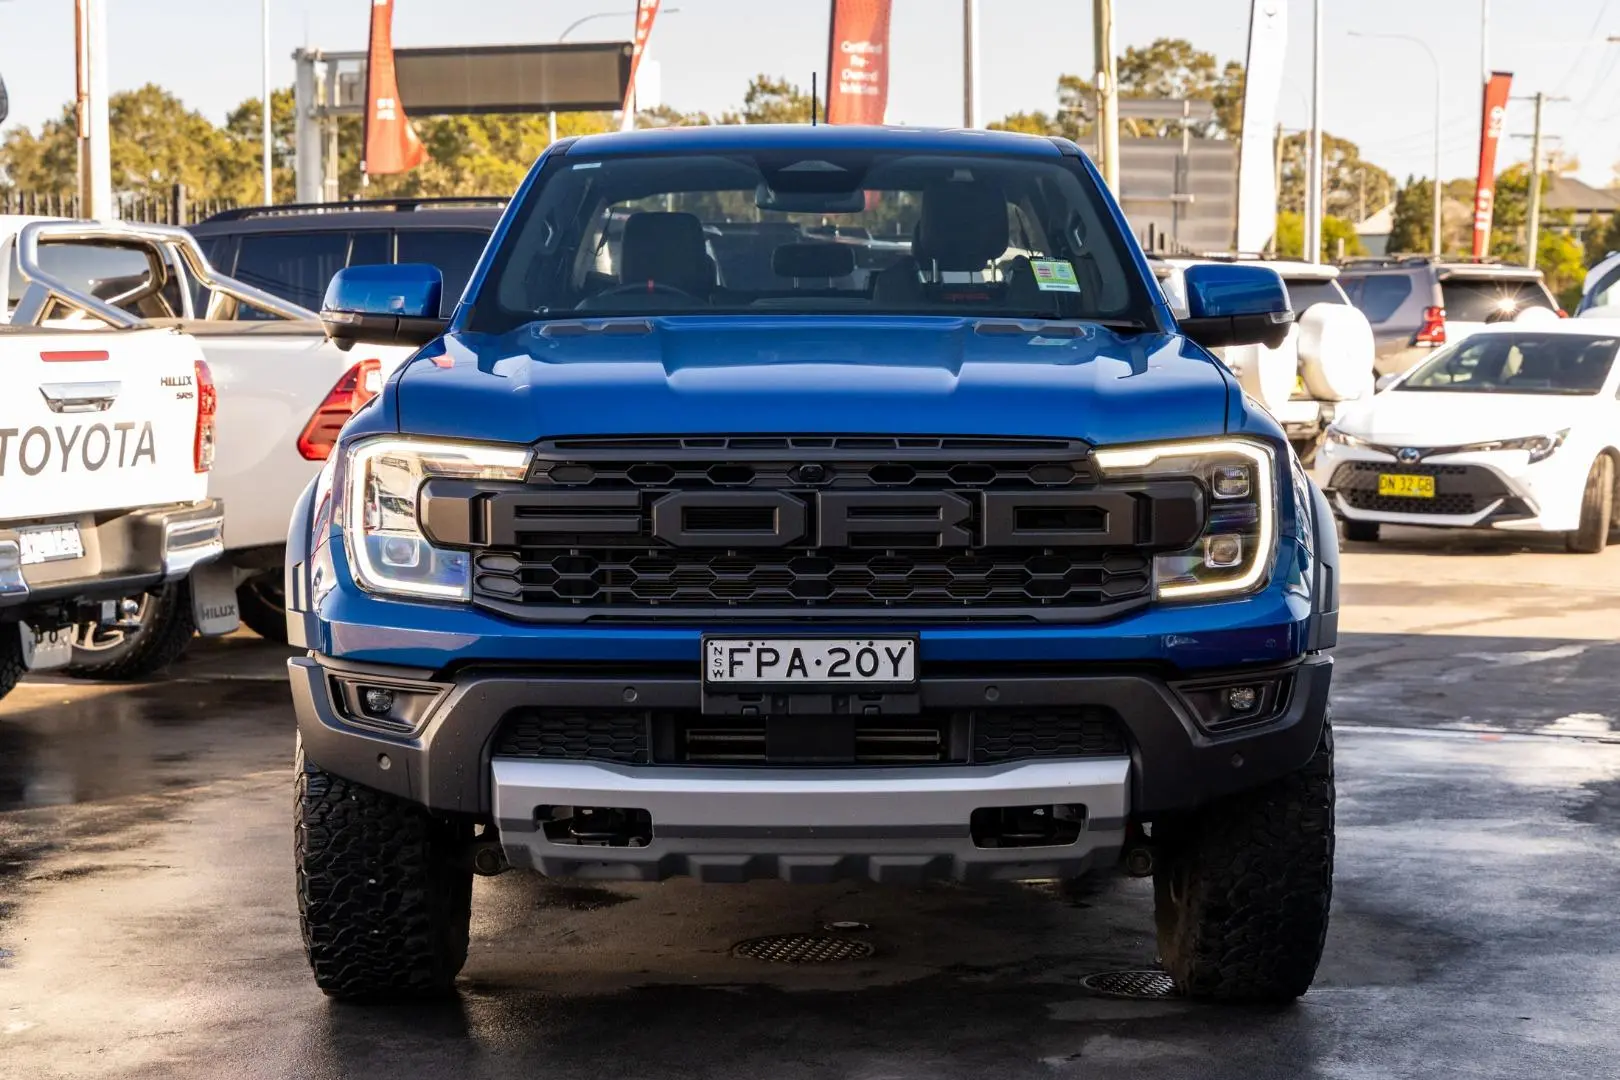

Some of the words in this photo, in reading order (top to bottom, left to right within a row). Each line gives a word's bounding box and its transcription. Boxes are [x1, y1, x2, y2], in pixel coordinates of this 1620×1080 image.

[160, 376, 193, 387] HILUX
[0, 421, 156, 476] TOYOTA
[487, 490, 1136, 546] FORD
[201, 604, 236, 621] HILUX
